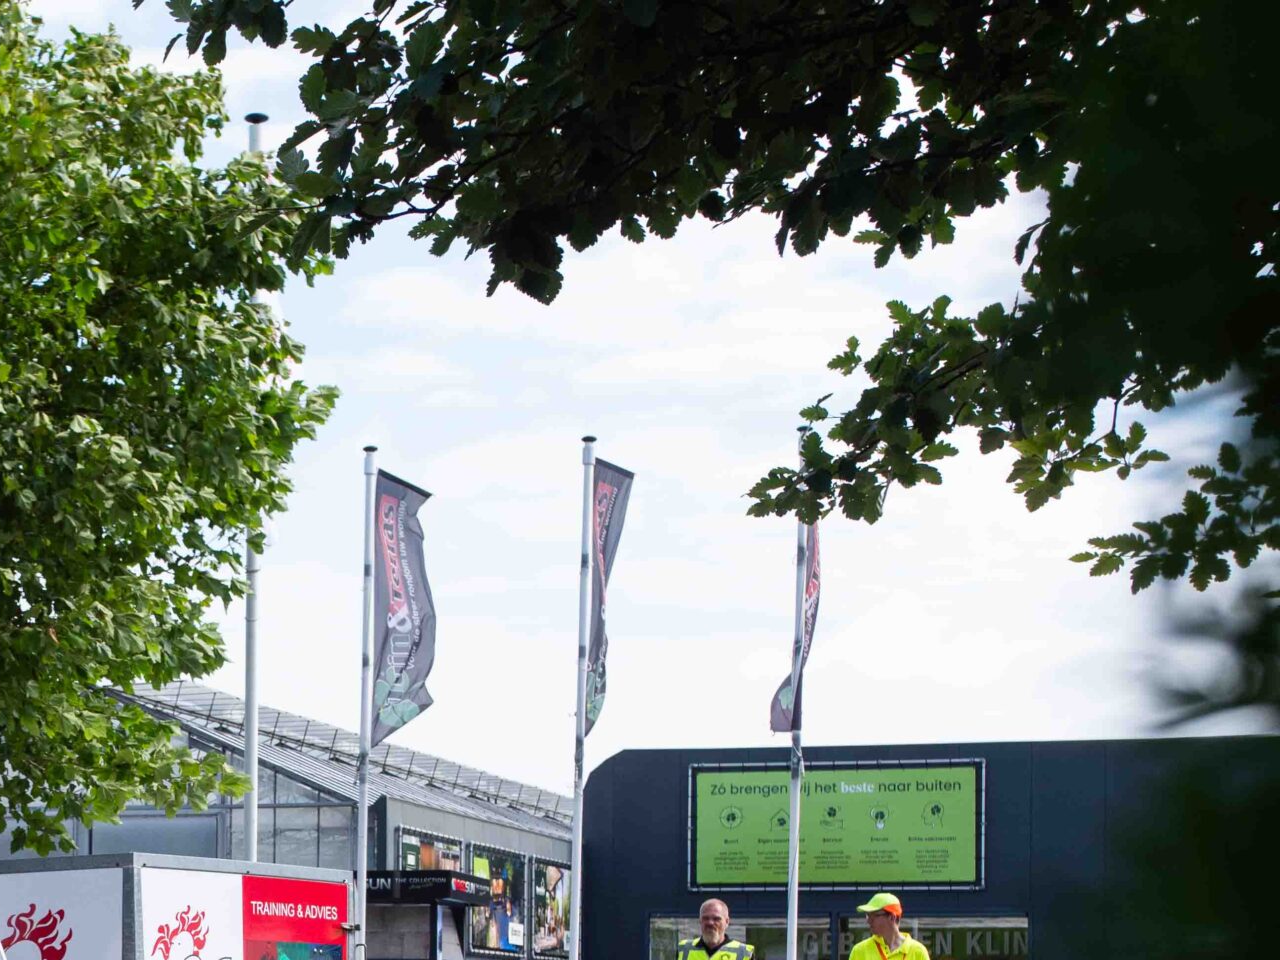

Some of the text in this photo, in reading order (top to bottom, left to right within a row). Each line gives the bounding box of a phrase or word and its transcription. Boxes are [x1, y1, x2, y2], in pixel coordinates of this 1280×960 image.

[398, 541, 408, 557] uw
[403, 558, 415, 597] rondom
[711, 783, 726, 796] Zó
[730, 783, 788, 798] brengen
[815, 781, 837, 794] het
[840, 781, 874, 793] beste
[878, 782, 911, 794] naar
[916, 780, 962, 793] buiten
[250, 901, 338, 920] TRAINING & ADVIES
